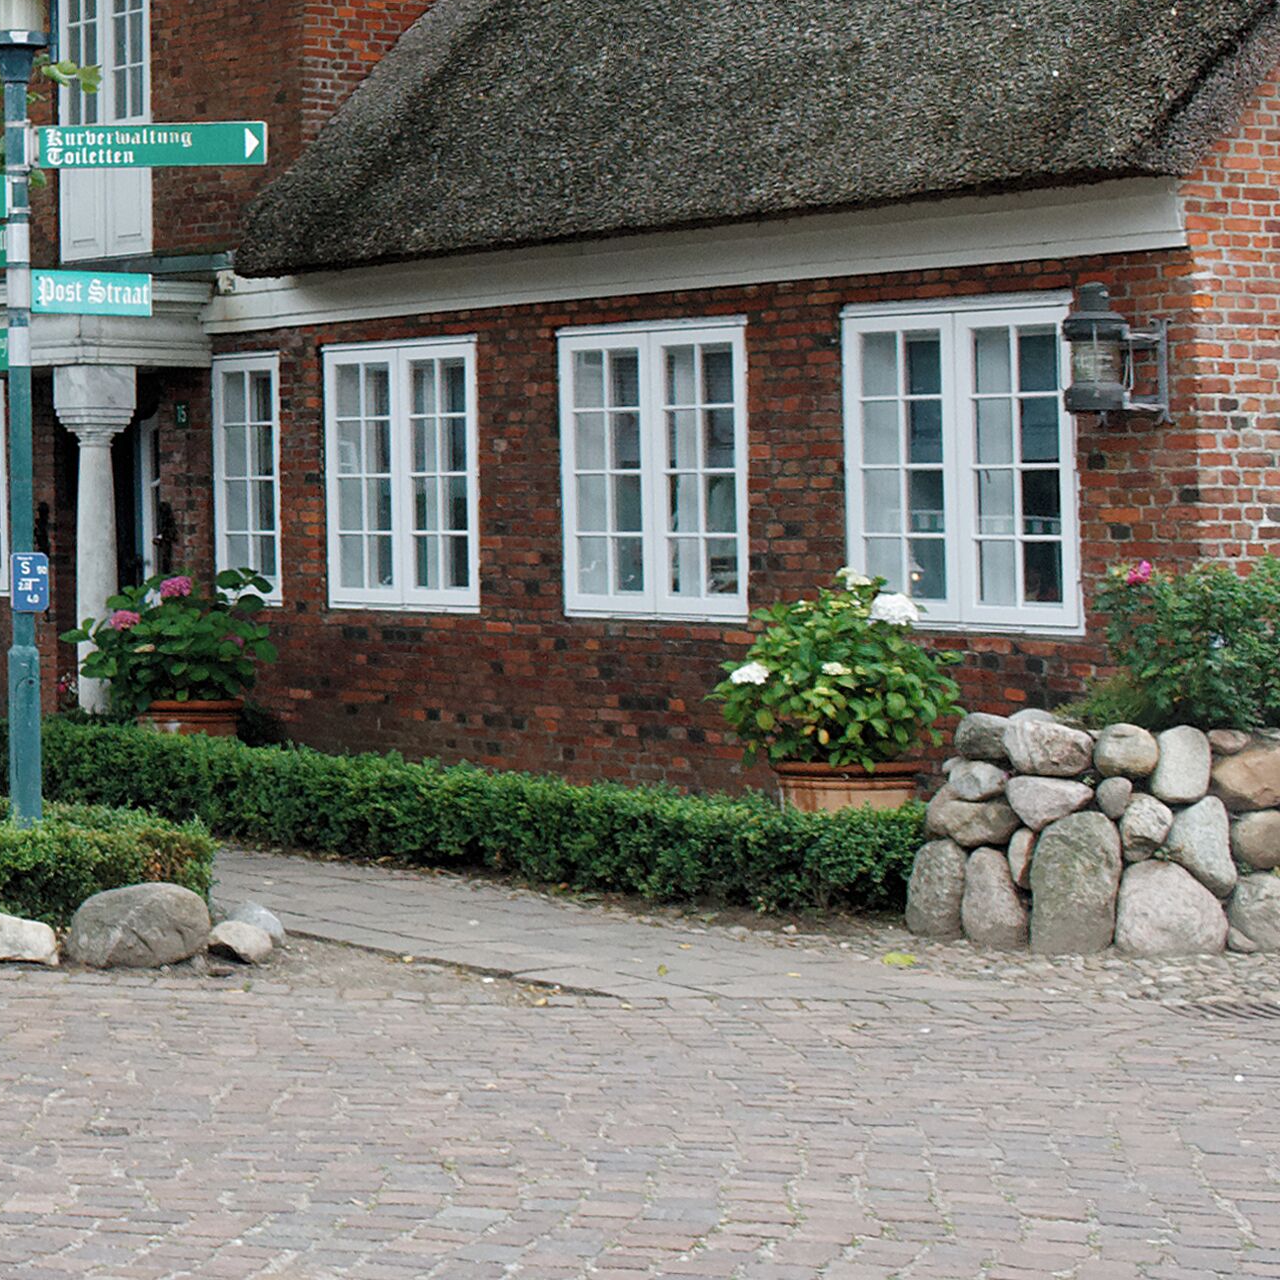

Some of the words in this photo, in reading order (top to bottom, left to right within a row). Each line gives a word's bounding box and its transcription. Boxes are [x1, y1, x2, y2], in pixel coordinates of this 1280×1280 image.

[45, 128, 193, 148] Kurverwaltung
[46, 147, 135, 166] Toiletten
[37, 276, 82, 306] Post
[88, 279, 149, 304] Straat
[20, 561, 31, 574] S
